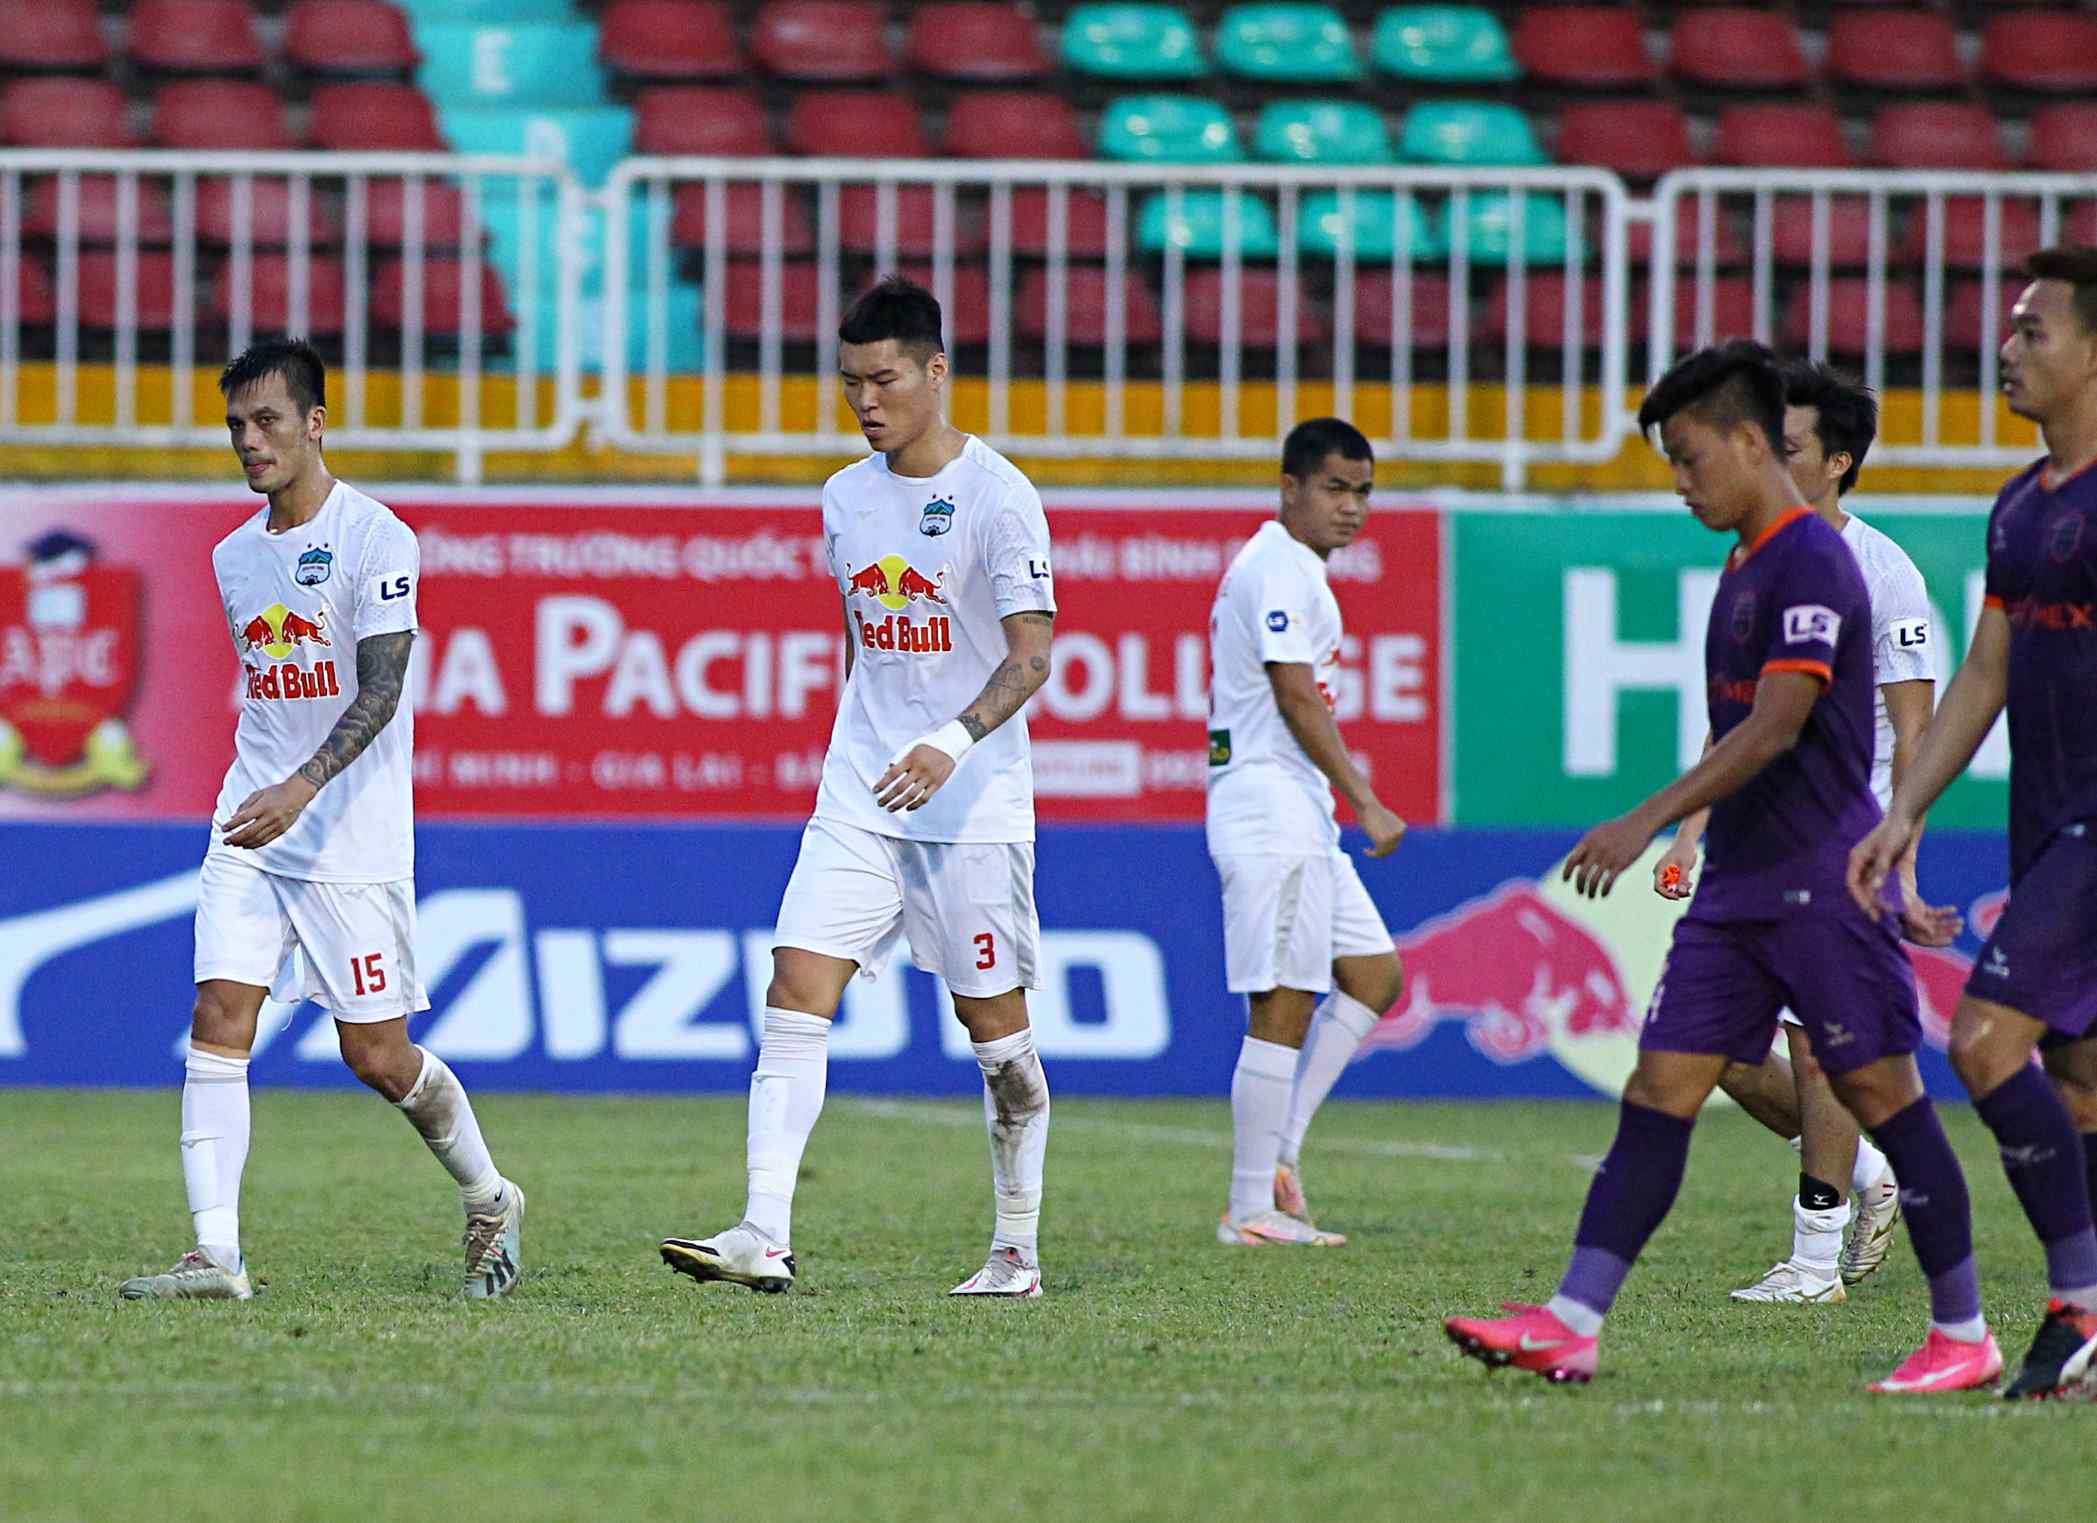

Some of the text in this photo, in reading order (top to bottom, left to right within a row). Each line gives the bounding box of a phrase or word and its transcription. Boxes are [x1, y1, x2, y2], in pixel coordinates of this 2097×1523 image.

[381, 576, 410, 600] LS
[896, 615, 952, 653] Bull
[1791, 613, 1829, 636] LS
[1900, 624, 1926, 647] LS
[534, 595, 846, 719] PACIF
[282, 660, 340, 699] Bull
[973, 932, 996, 970] 3
[350, 952, 387, 997] 15
